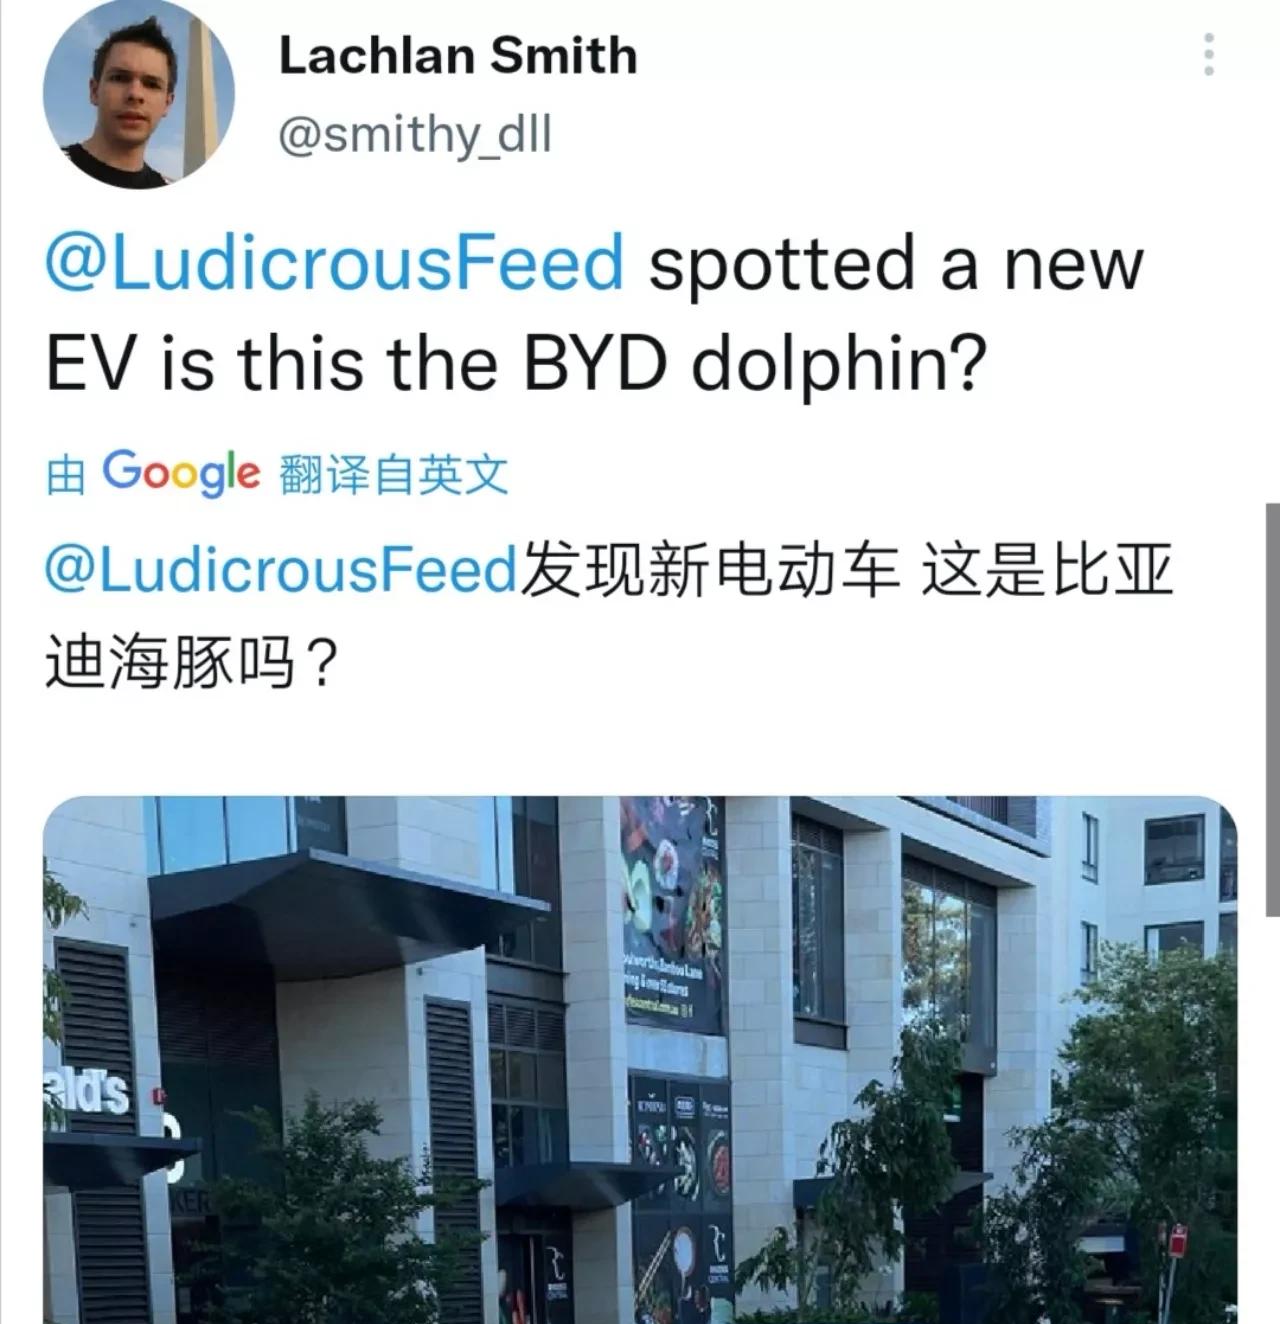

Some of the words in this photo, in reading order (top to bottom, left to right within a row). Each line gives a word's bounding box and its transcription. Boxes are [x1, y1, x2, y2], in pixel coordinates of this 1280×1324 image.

[281, 35, 474, 75] Lachlan
[491, 35, 637, 75] Smith
[279, 113, 551, 162] @smithy_dll
[46, 230, 623, 293] @LudicrousFeed
[650, 232, 914, 305] spotted
[942, 247, 978, 291] a
[1006, 247, 1144, 291] new
[48, 333, 138, 391] EV
[162, 333, 215, 392] is
[237, 332, 364, 392] this
[386, 332, 498, 392] the
[526, 333, 668, 391] BYD
[692, 332, 987, 405] dolphin?
[47, 452, 85, 496] 由
[103, 449, 261, 499] Google
[279, 452, 509, 496] 翻译自英文
[922, 539, 1174, 599] 这是比亚
